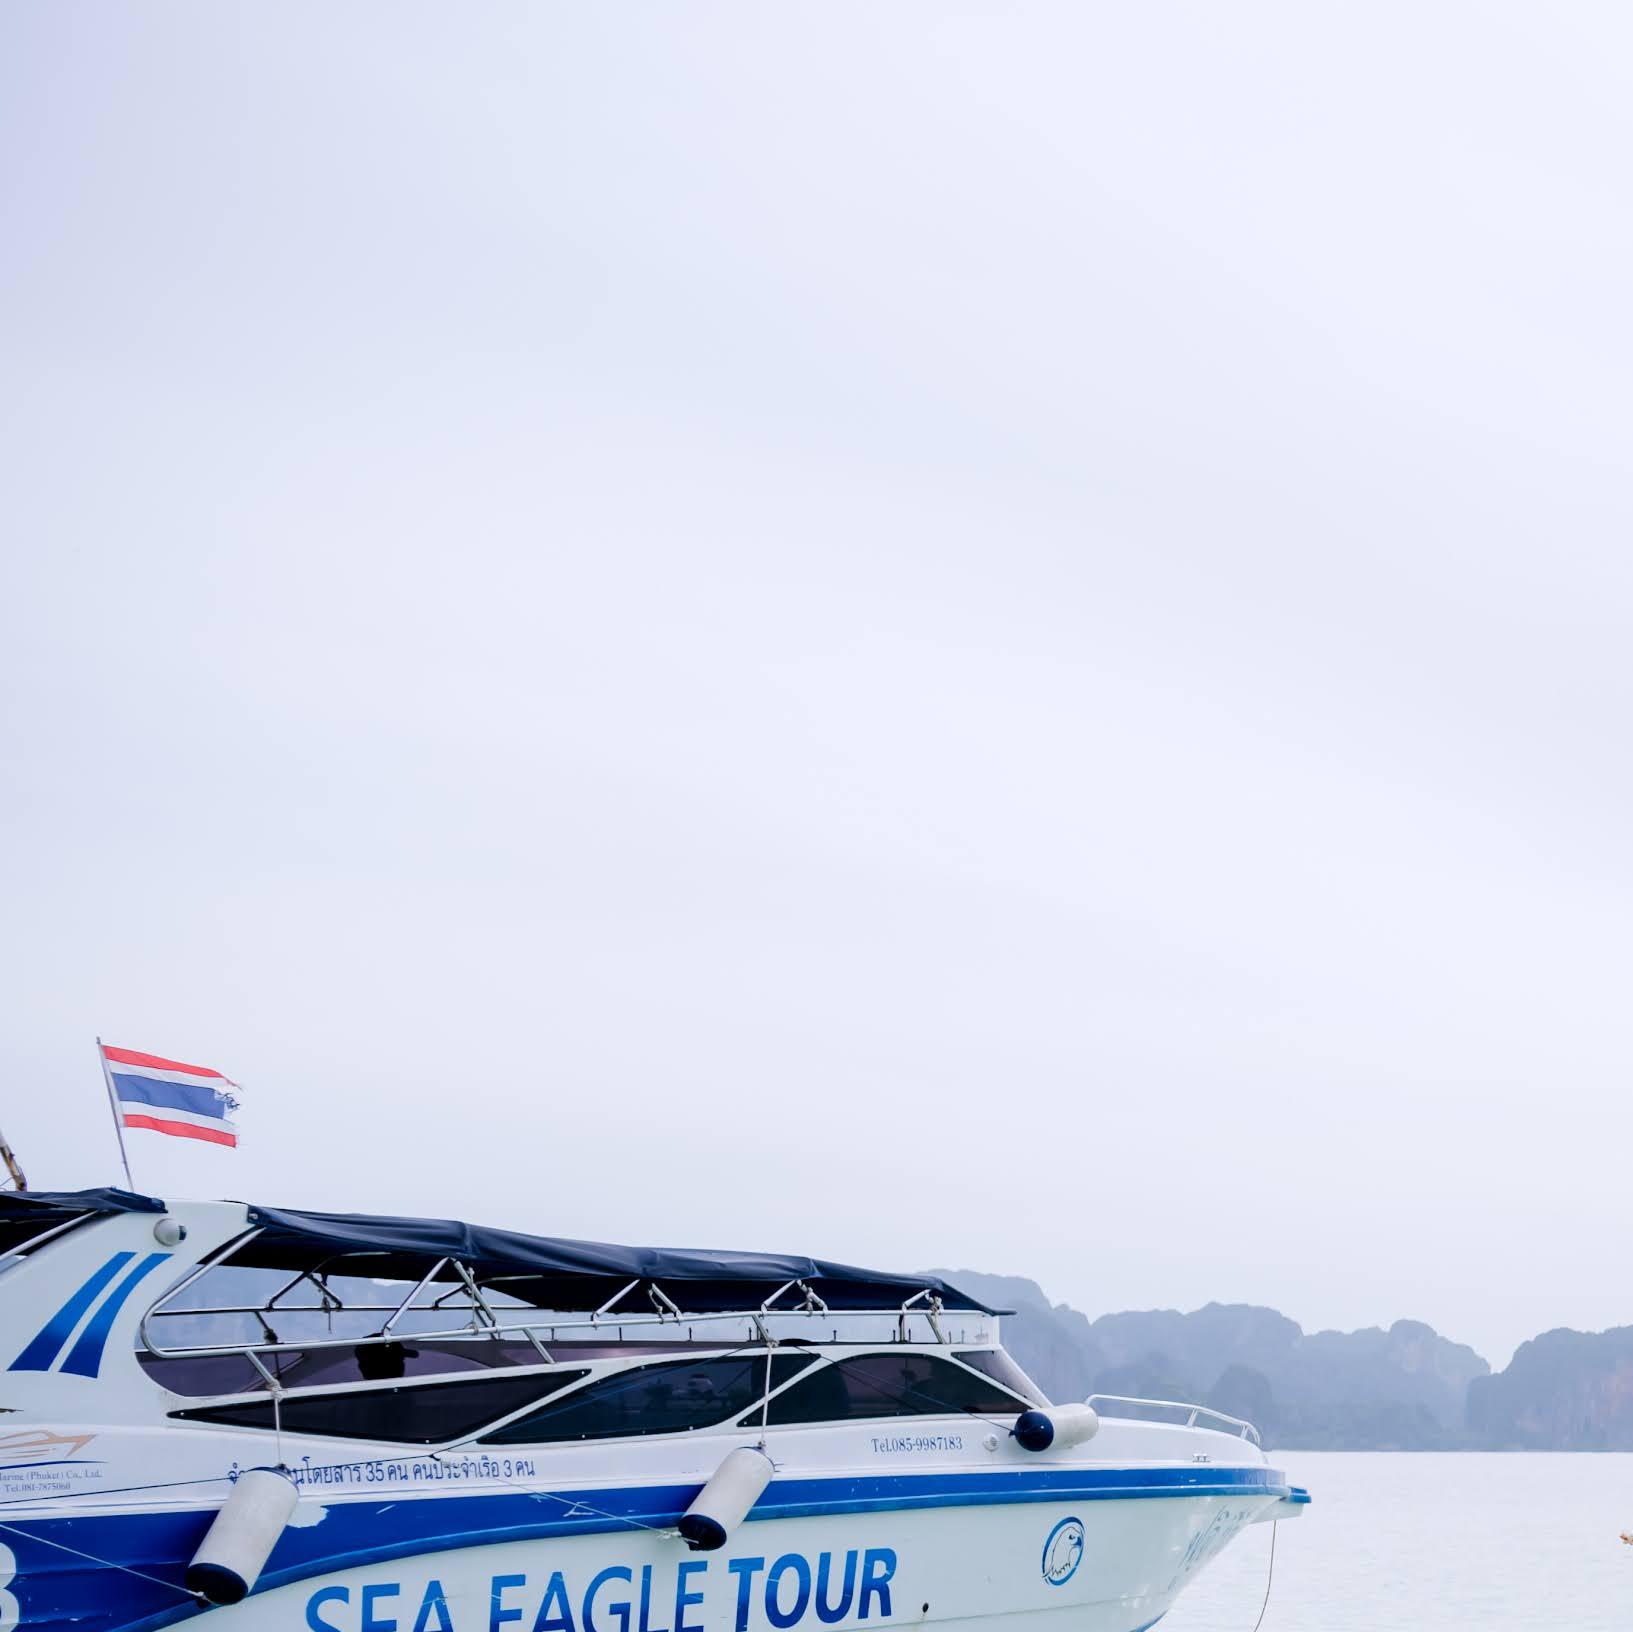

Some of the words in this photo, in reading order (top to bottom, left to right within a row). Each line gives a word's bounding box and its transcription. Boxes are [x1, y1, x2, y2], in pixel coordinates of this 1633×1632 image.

[871, 1436, 963, 1453] Tel.085-9987183
[0, 1471, 24, 1481] arine
[366, 1462, 385, 1482] 35
[388, 1463, 409, 1481] คน
[503, 1459, 512, 1478] 3
[516, 1460, 536, 1477] คน
